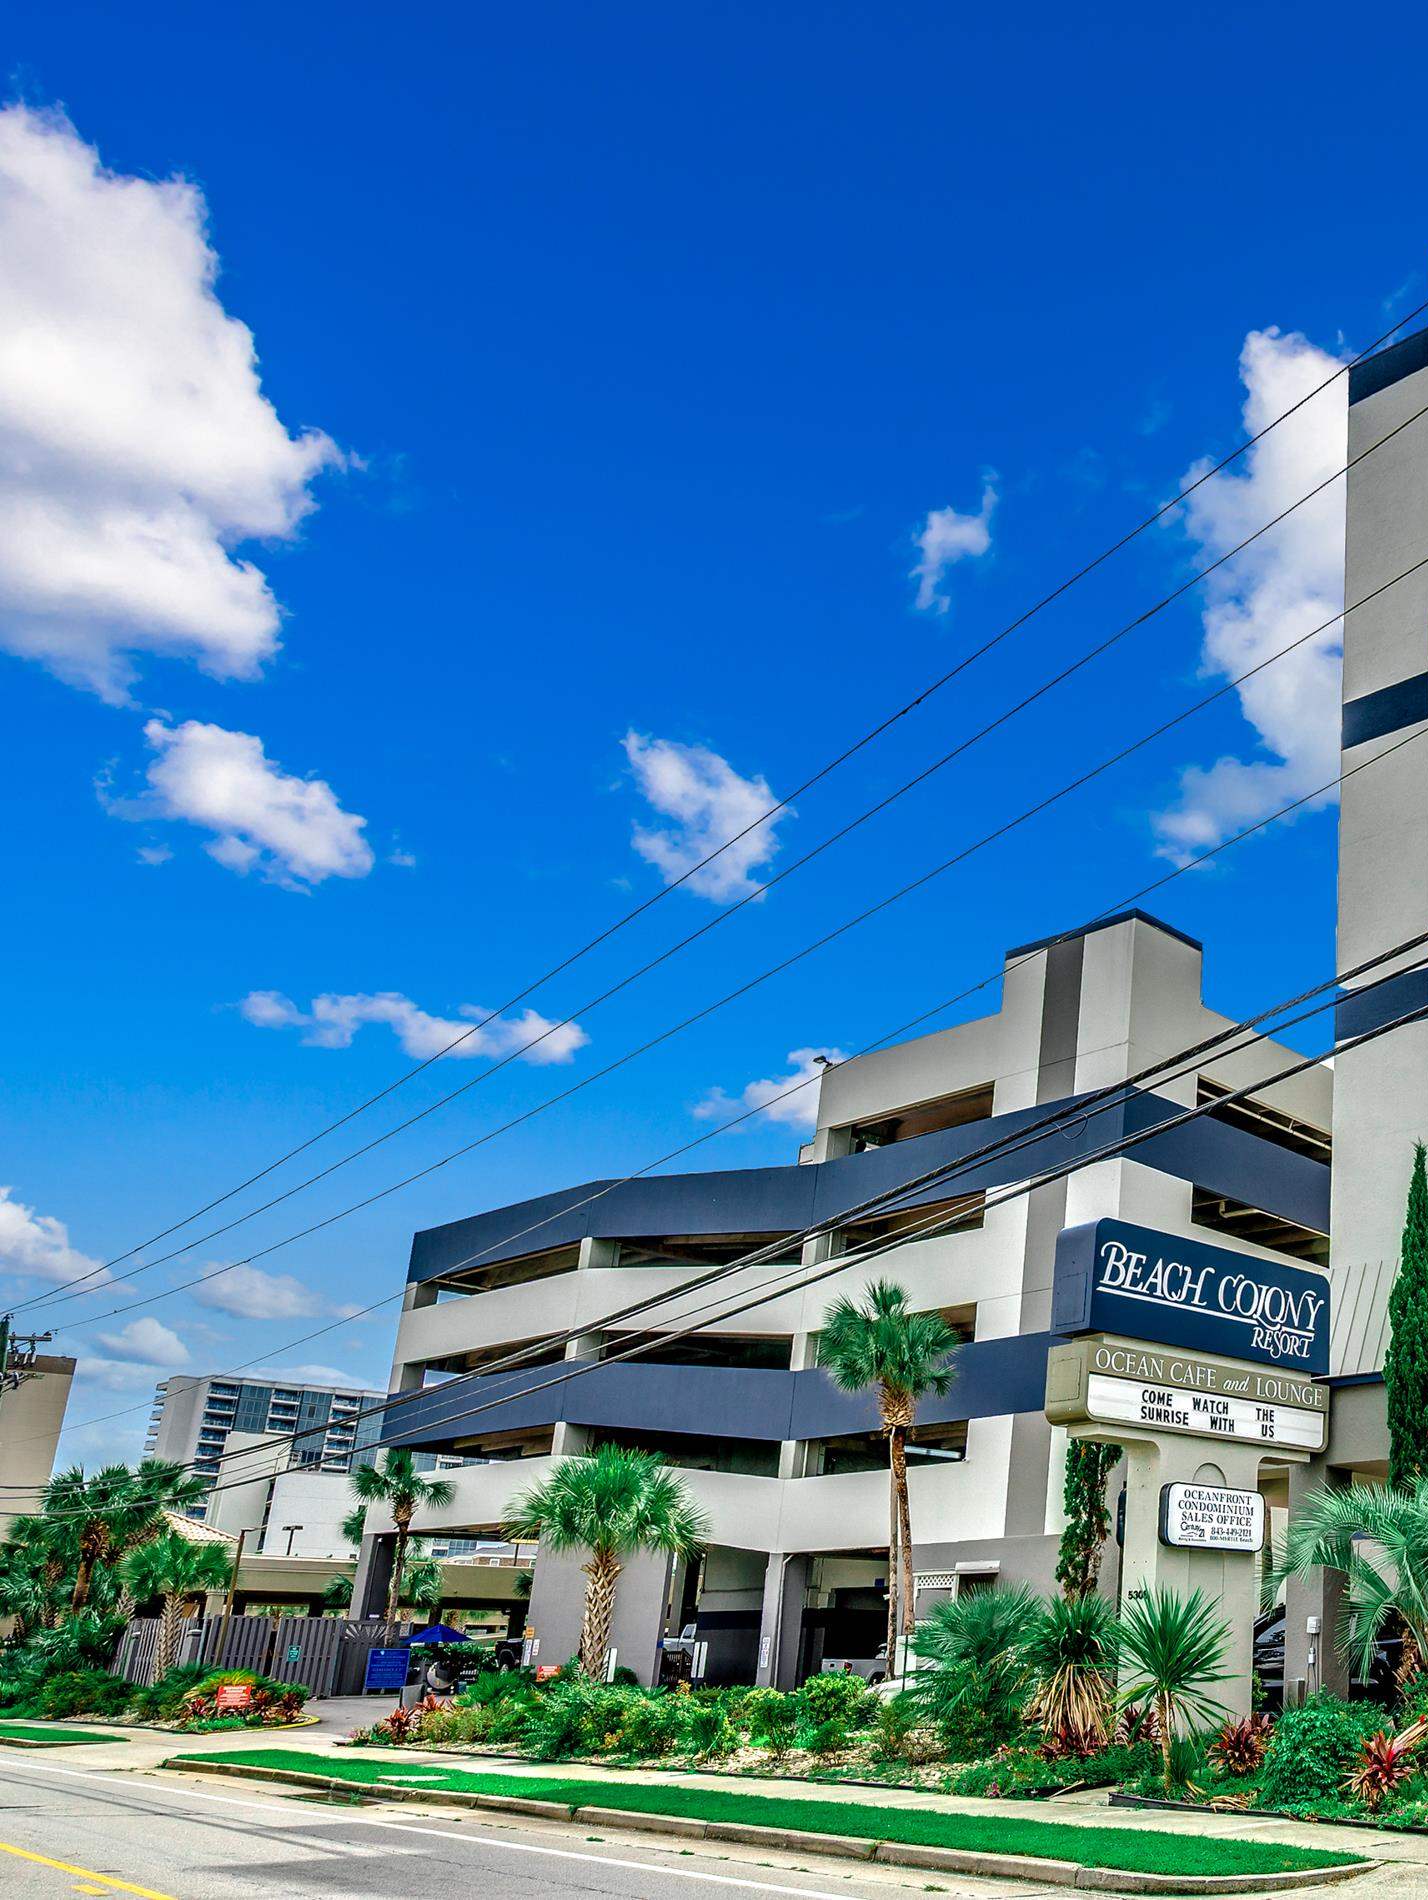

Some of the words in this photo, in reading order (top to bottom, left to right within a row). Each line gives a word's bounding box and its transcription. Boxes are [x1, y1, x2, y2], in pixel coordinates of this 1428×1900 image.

[1100, 1241, 1215, 1306] BEACH
[1218, 1274, 1324, 1331] COLONY
[1251, 1327, 1313, 1359] RESORT
[1095, 1348, 1163, 1378] OCEAN
[1170, 1362, 1216, 1389] CAFE
[1223, 1376, 1249, 1392] and
[1256, 1377, 1323, 1407] LOUNGE
[1141, 1389, 1173, 1407] COME
[1192, 1397, 1229, 1415] WATCH
[1256, 1407, 1275, 1422] THE
[1141, 1405, 1189, 1426] SUNRISE
[1210, 1415, 1235, 1433] WITH
[1261, 1424, 1274, 1438] US
[1178, 1500, 1254, 1516] CONDOMINIUM
[1184, 1489, 1252, 1505] OCEANFRONT
[1181, 1510, 1213, 1523] SALES
[1216, 1514, 1252, 1527] OFFICE
